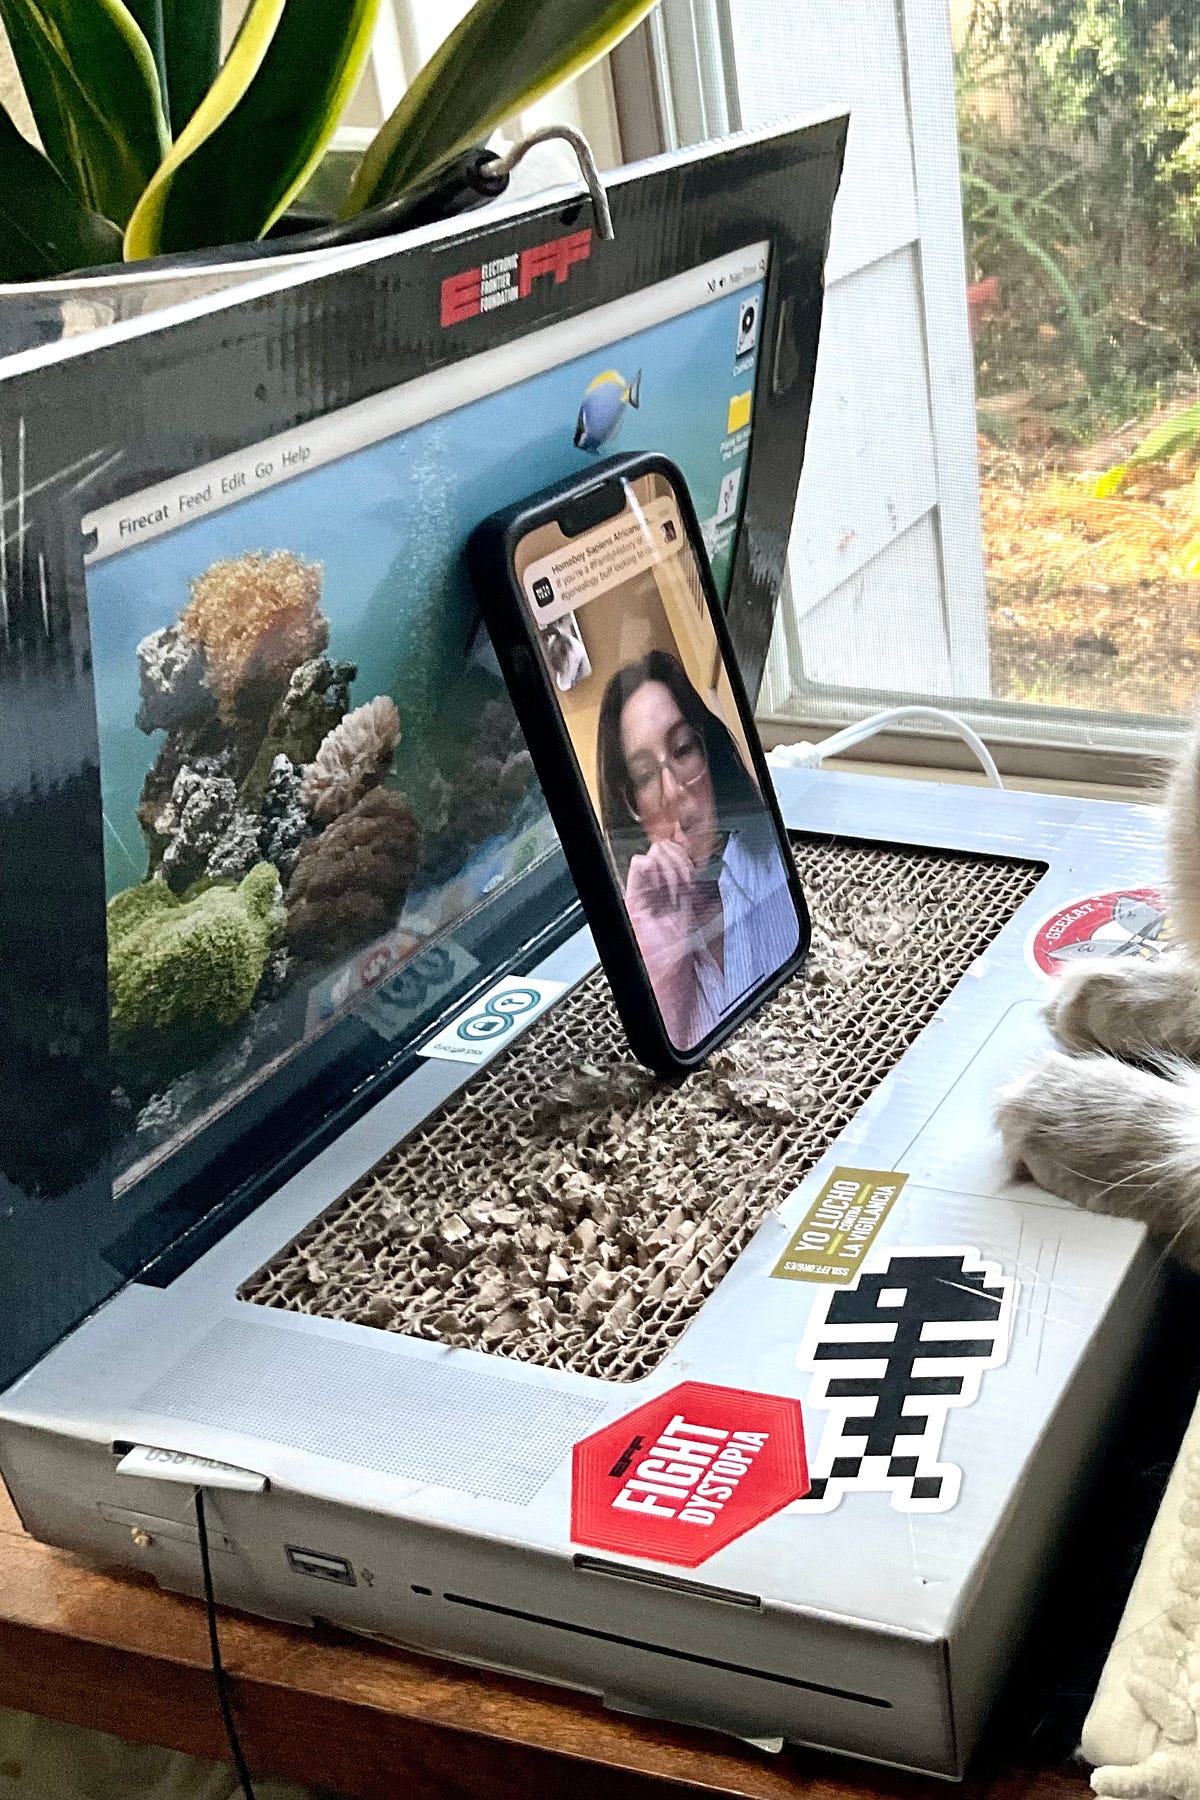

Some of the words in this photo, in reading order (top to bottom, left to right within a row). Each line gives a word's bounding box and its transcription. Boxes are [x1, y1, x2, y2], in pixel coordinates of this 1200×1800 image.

[441, 229, 592, 328] EFF
[118, 505, 170, 537] Firecat
[179, 486, 212, 512] Feed
[220, 471, 247, 494] Edit
[255, 460, 274, 479] Go
[281, 444, 311, 468] Help
[552, 551, 586, 574] Homeboy
[586, 538, 614, 557] Sapiens
[1045, 903, 1097, 940] GEEKAT
[809, 1180, 861, 1230] LUCHO
[838, 1205, 864, 1232] CONTRA
[847, 1184, 897, 1242] VIGILANCIA
[794, 1230, 831, 1251] YO
[838, 1243, 864, 1258] LA
[611, 1414, 730, 1519] FIGHT
[677, 1430, 770, 1526] DYSTOPIA
